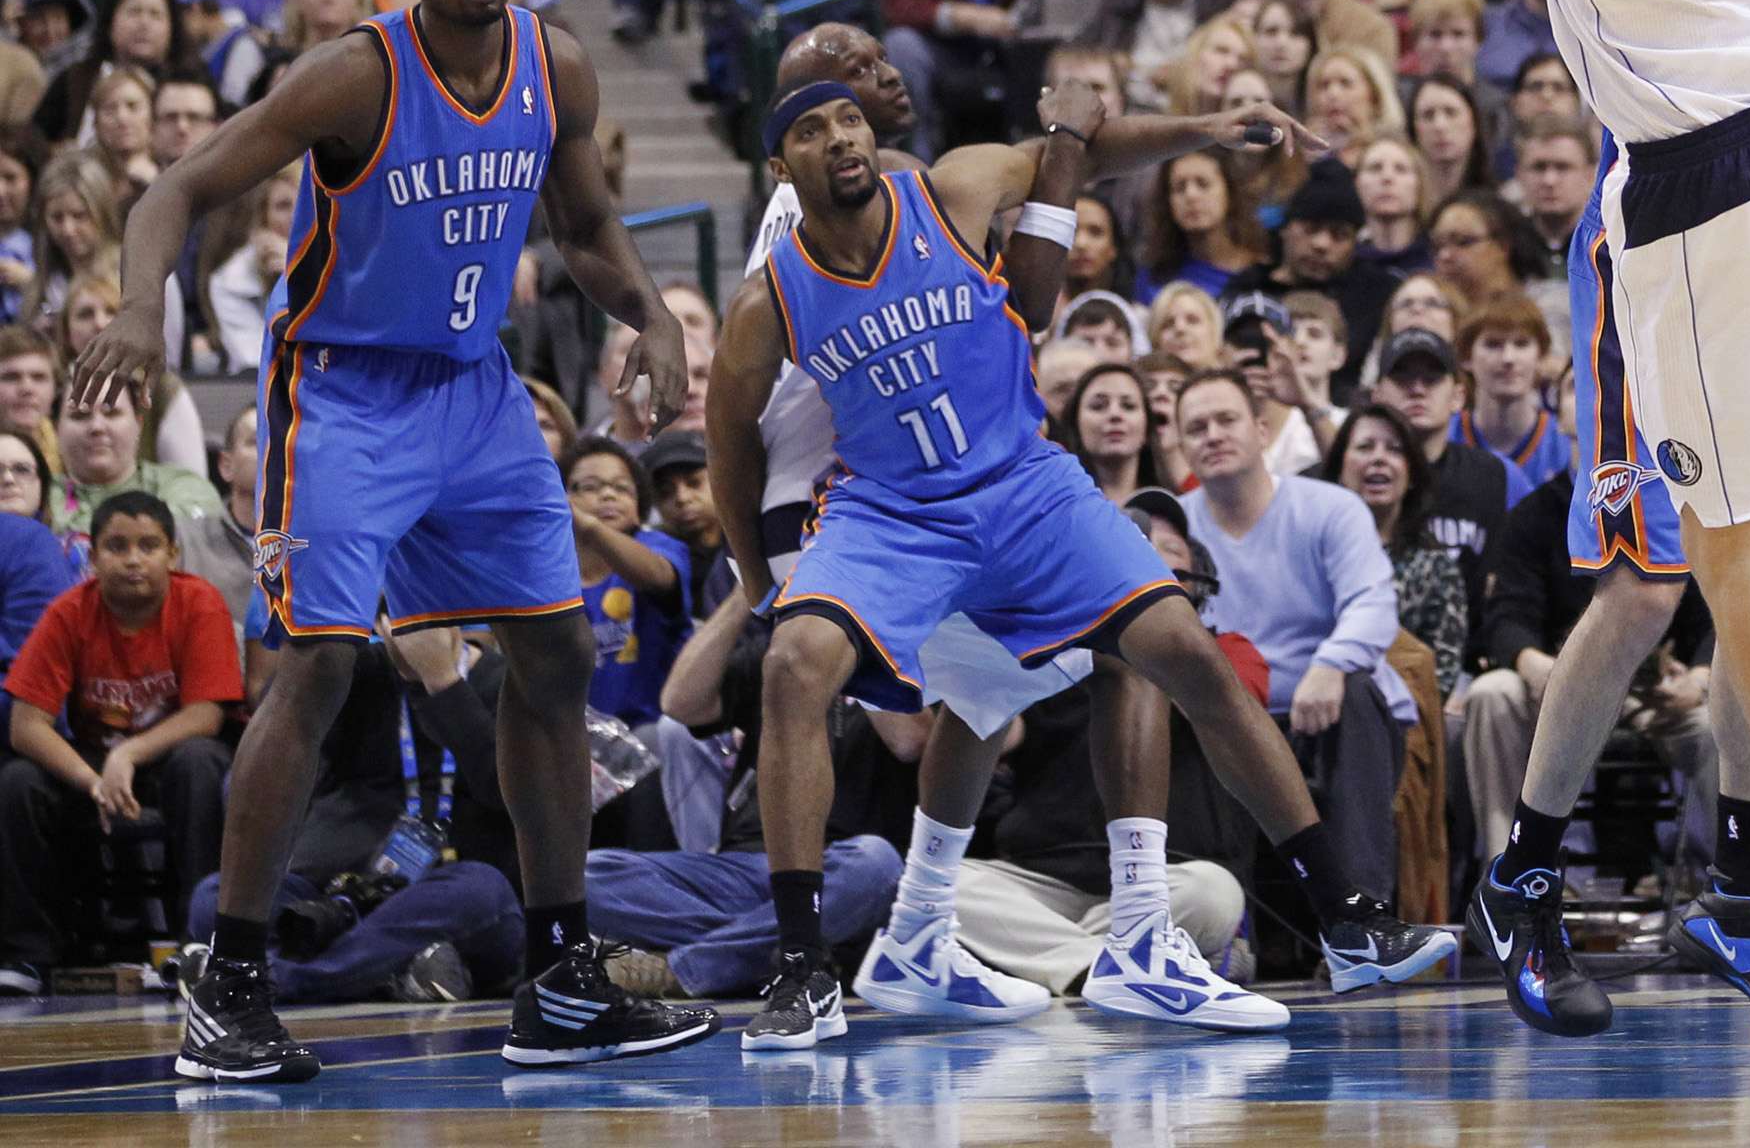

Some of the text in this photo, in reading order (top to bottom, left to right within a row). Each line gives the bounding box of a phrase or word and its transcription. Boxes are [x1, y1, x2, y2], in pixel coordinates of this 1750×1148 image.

[443, 202, 509, 245] CITY
[449, 264, 485, 332] 9
[808, 284, 974, 383] OKLAHOMA
[868, 341, 941, 397] CITY
[899, 392, 969, 470] 11
[1594, 471, 1628, 507] OKC
